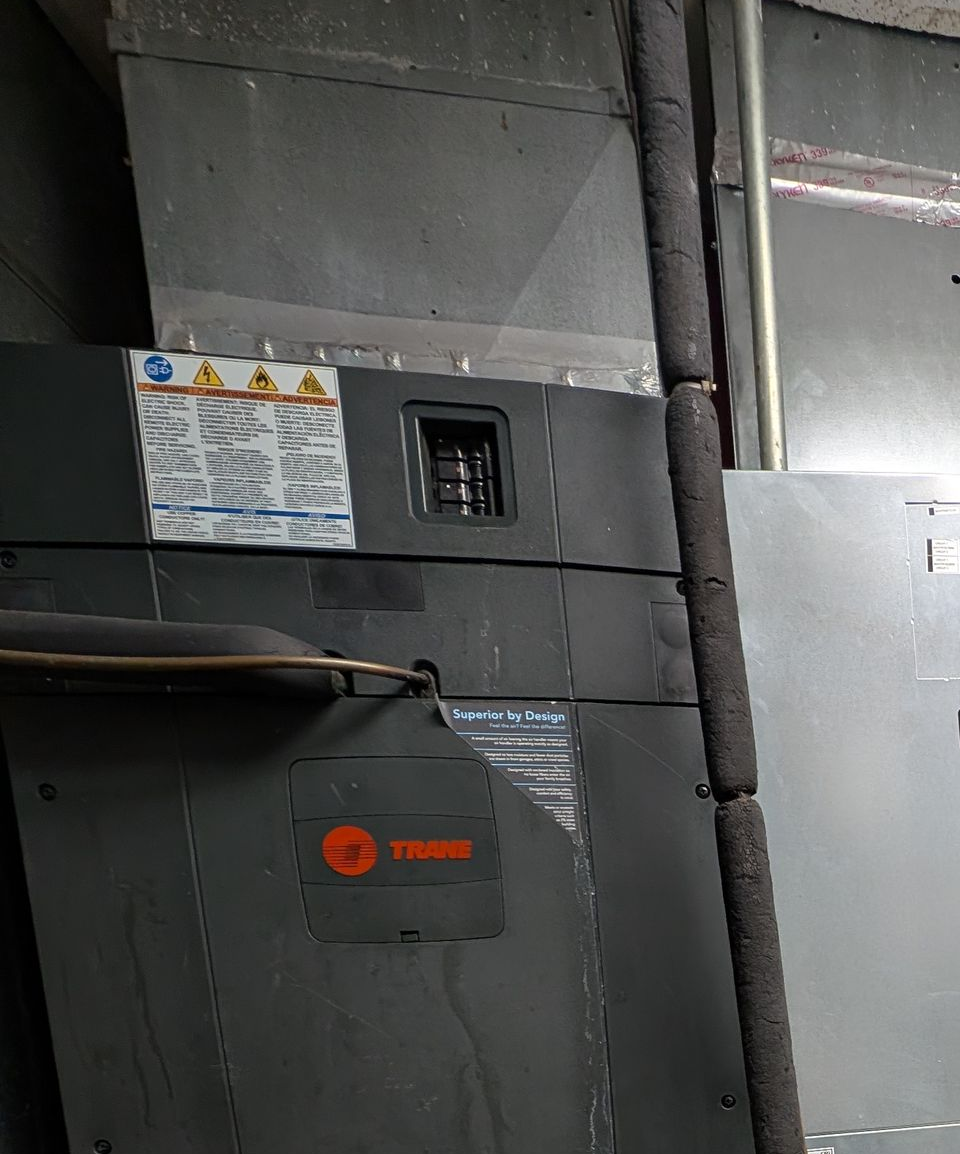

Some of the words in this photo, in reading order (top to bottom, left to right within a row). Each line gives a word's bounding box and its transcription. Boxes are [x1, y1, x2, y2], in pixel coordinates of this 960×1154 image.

[151, 385, 188, 394] WARNING
[453, 709, 504, 721] Superior
[507, 710, 522, 722] by
[525, 711, 565, 723] Design
[389, 839, 472, 860] TRANE
